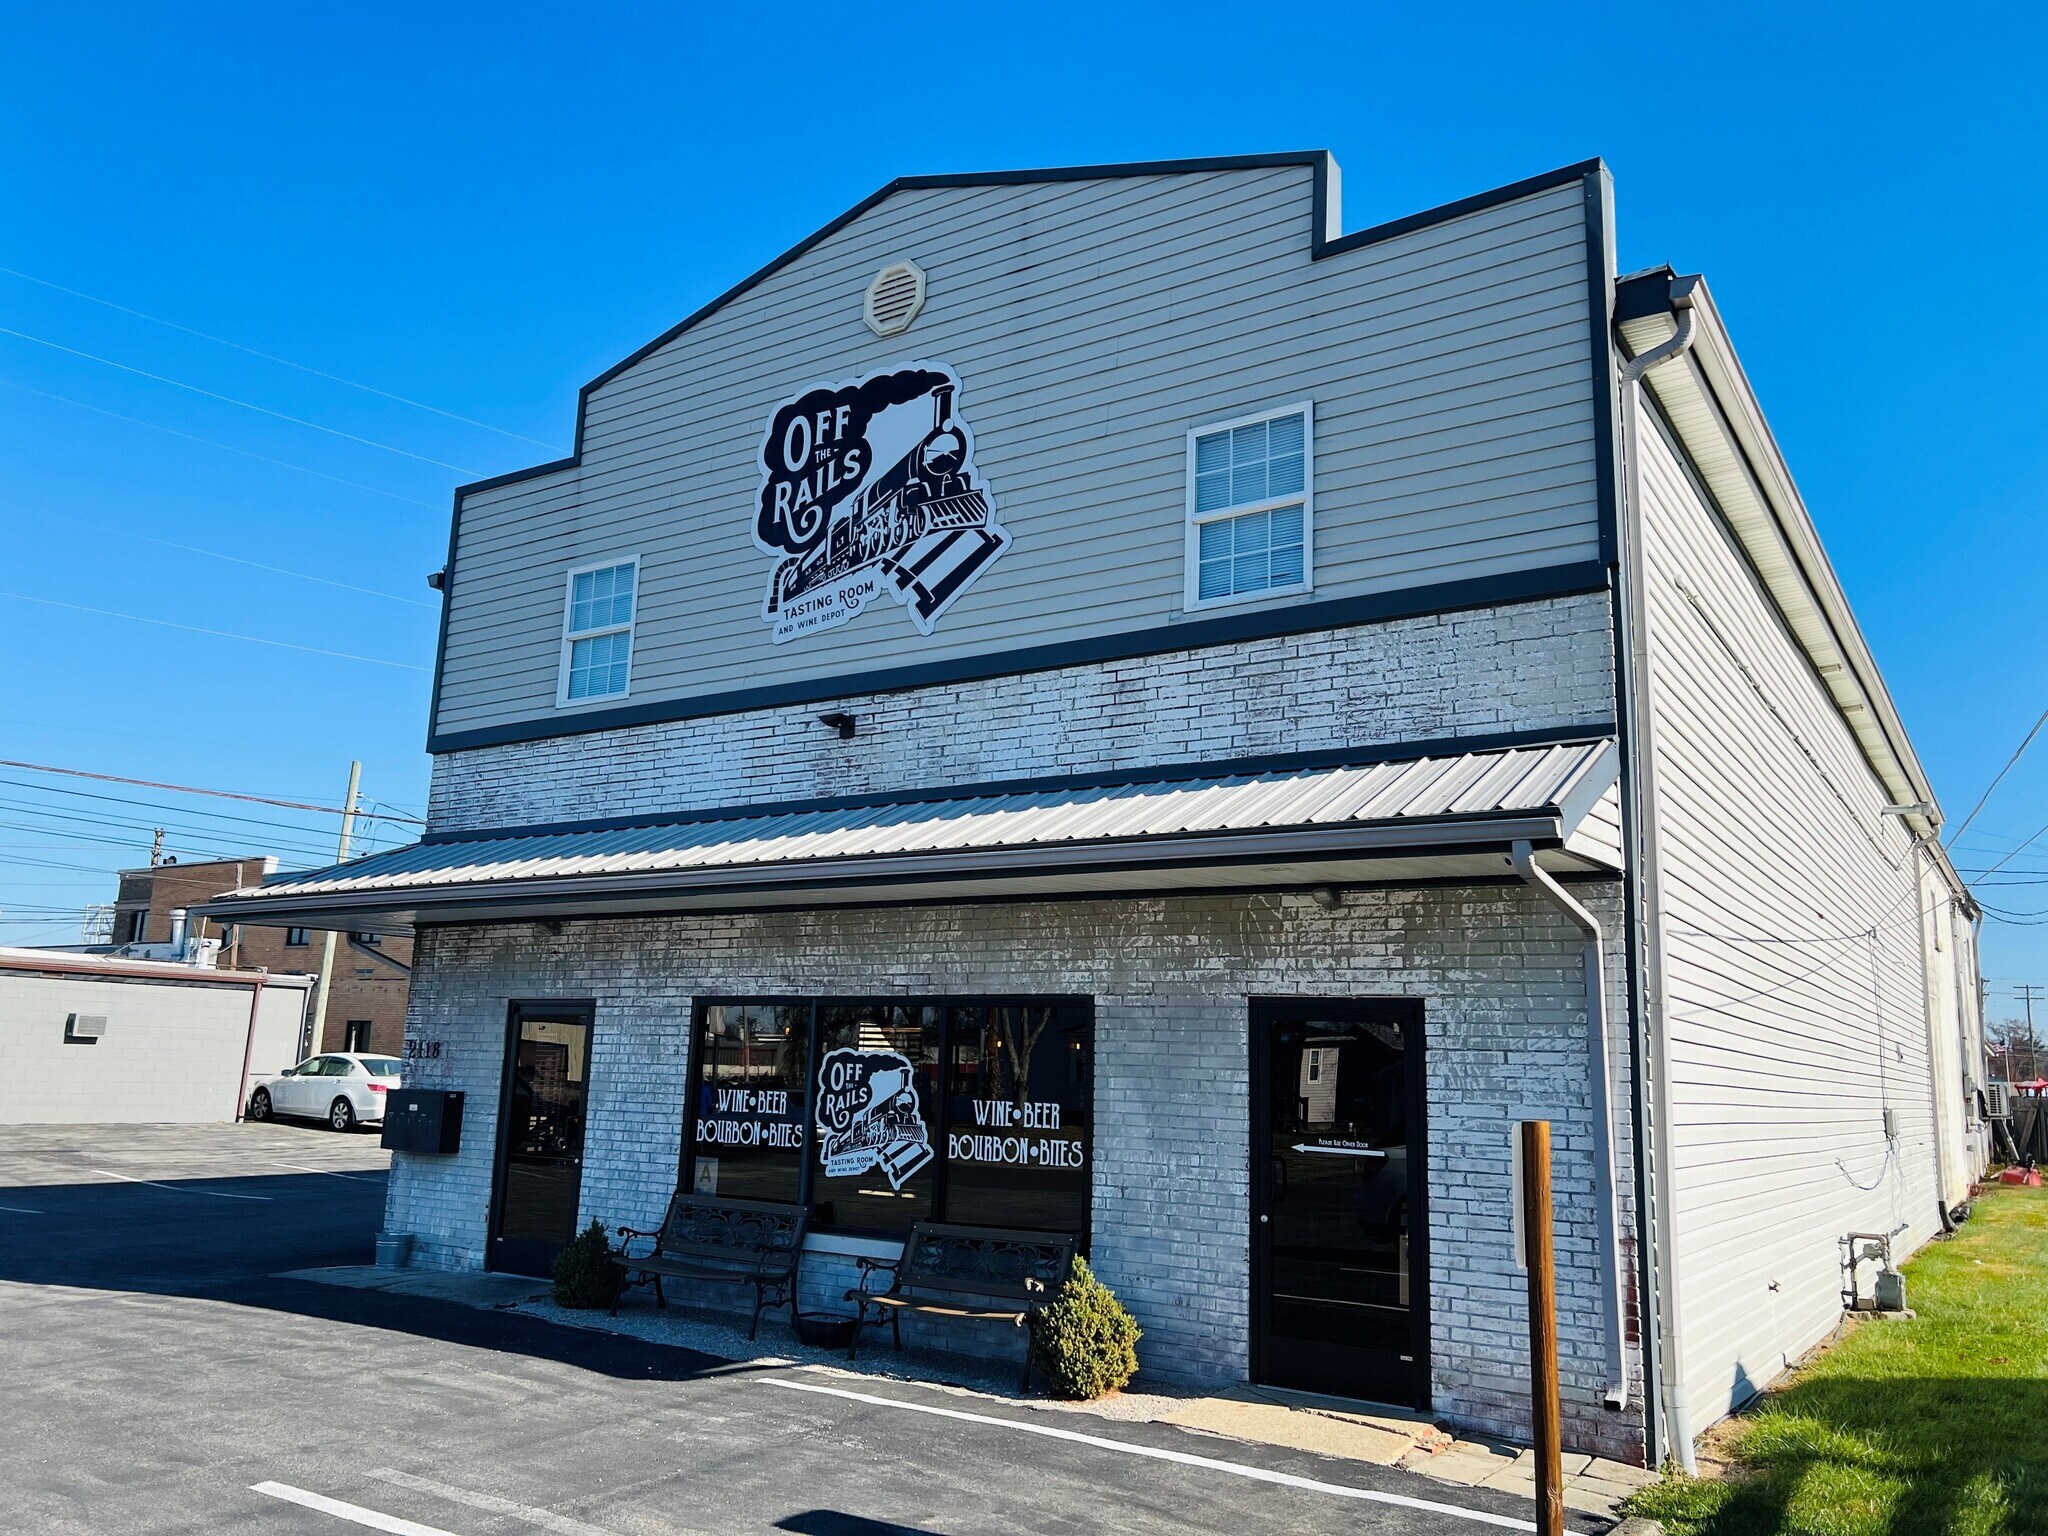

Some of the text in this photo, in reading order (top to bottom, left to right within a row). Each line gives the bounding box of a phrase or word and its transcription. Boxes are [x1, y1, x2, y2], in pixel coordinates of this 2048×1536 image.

[783, 405, 851, 472] OFF
[815, 448, 831, 463] THE
[773, 448, 861, 543] RAILS
[784, 581, 874, 620] TASTING ROOM
[779, 609, 845, 636] AND WINE DEPOT
[409, 1041, 440, 1058] 2118
[830, 1062, 863, 1091] OFF
[826, 1087, 868, 1129] RAILS
[699, 1165, 711, 1182] A
[831, 1156, 874, 1168] TASTING ROOM
